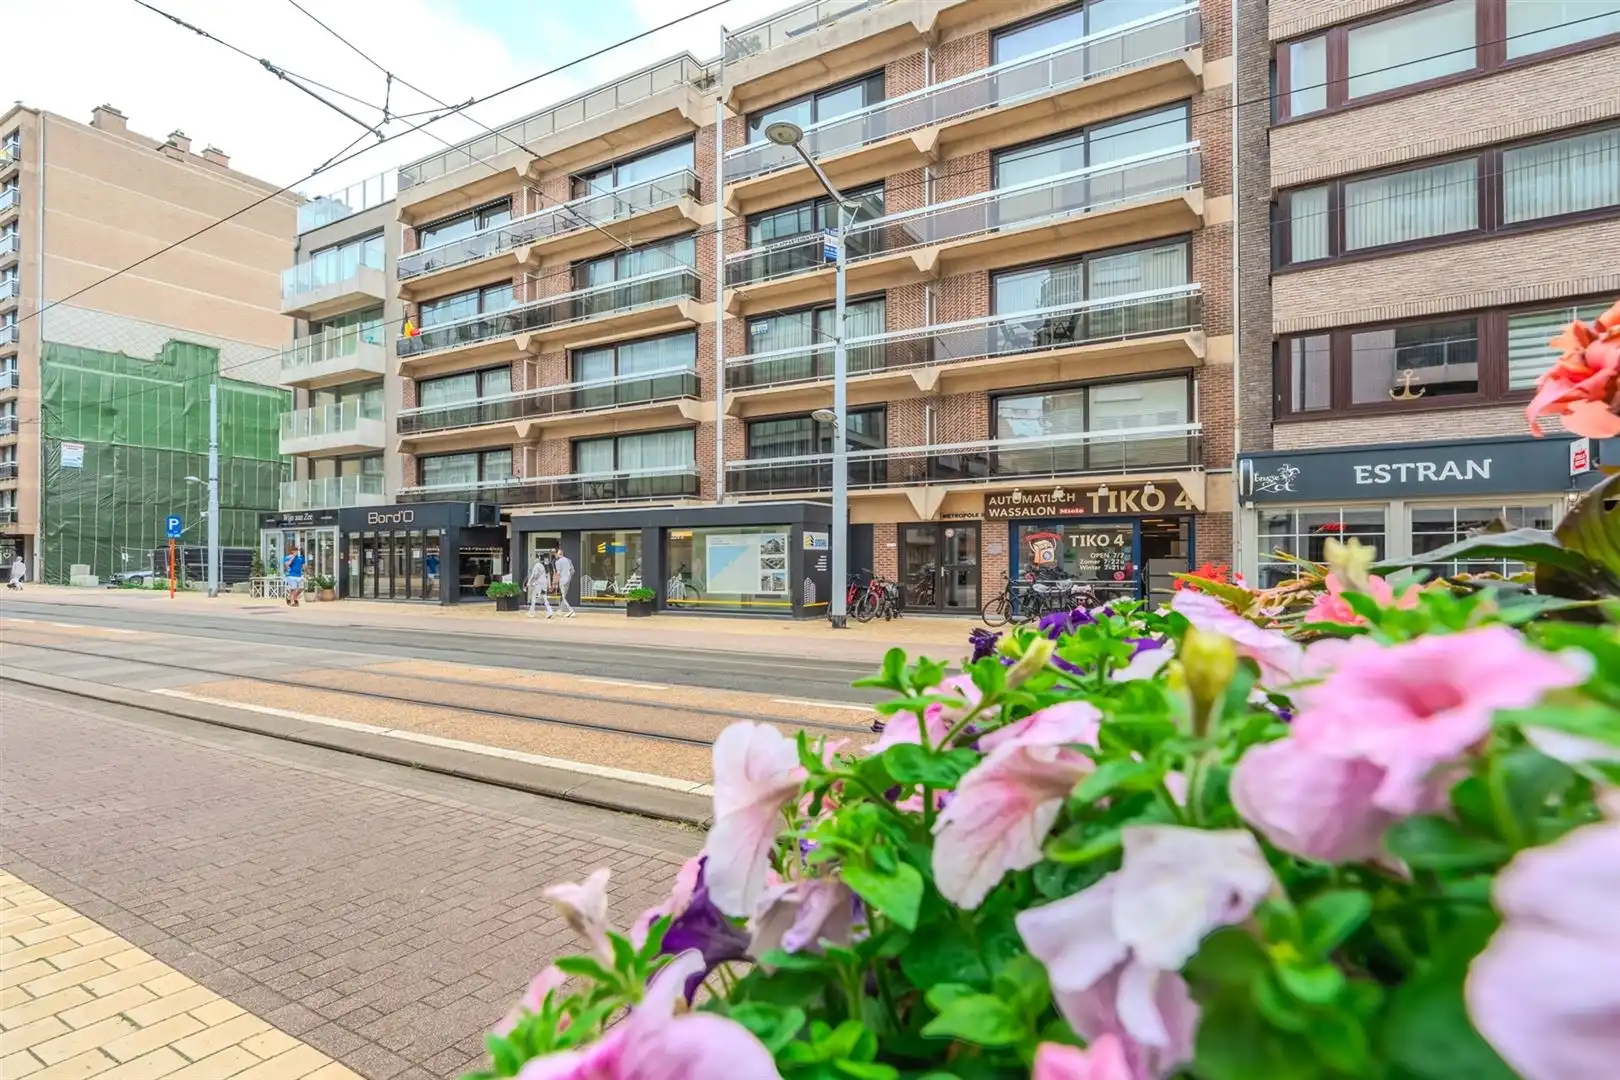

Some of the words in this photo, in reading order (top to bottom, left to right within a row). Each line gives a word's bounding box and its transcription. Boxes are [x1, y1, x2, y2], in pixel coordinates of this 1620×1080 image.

[1353, 458, 1493, 485] ESTRAN
[1086, 489, 1166, 514] TIKO
[1174, 489, 1193, 512] 4
[989, 506, 1056, 518] WASSALON
[168, 518, 180, 531] P
[1069, 534, 1110, 548] TIKO
[1113, 534, 1125, 547] 4
